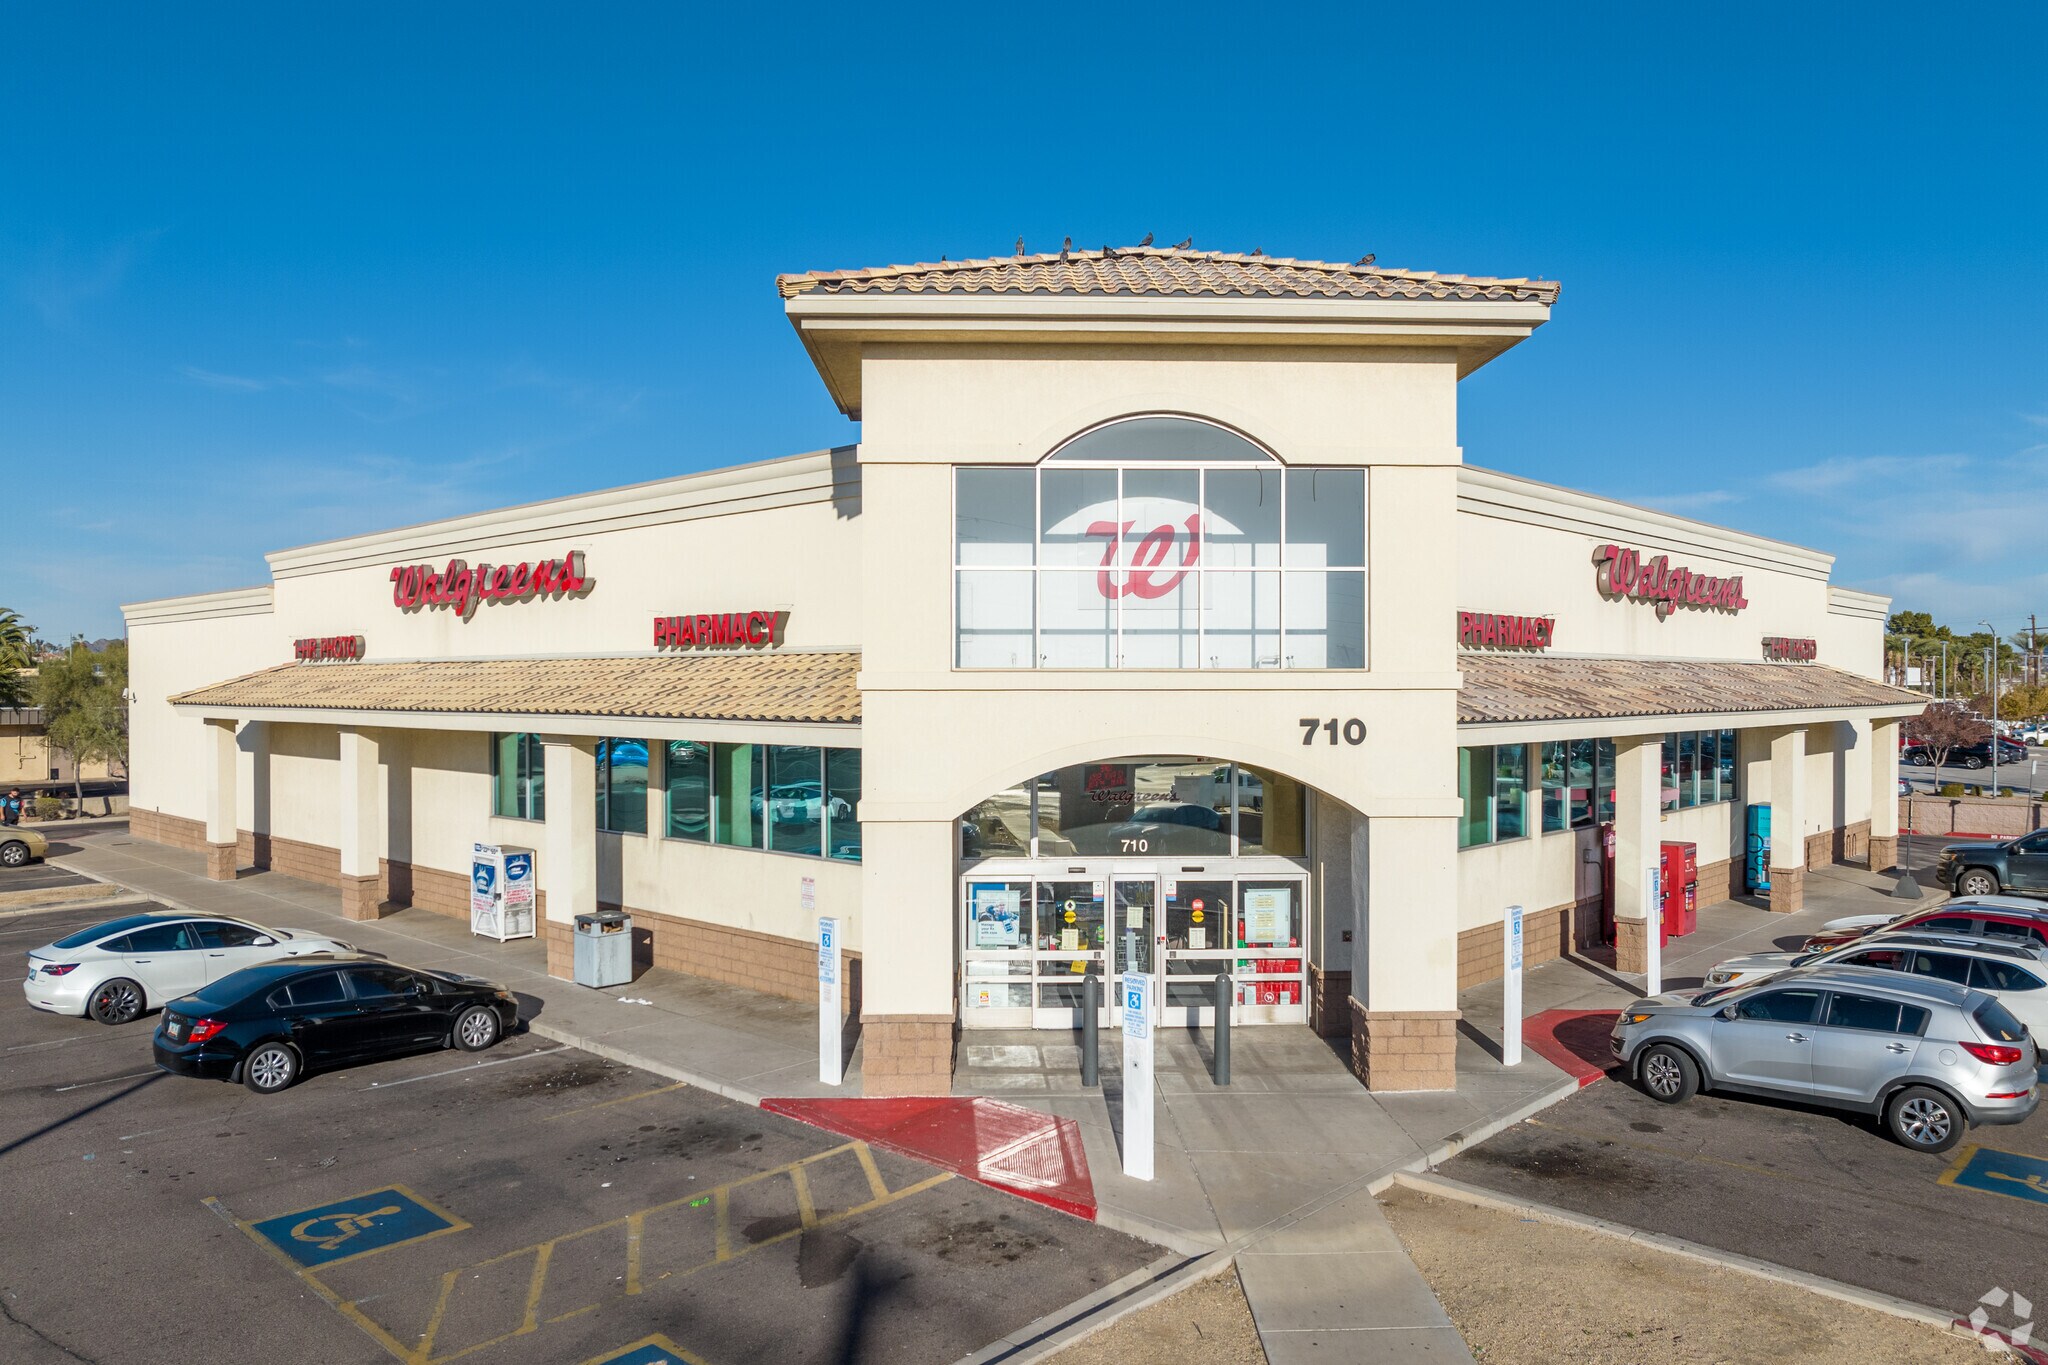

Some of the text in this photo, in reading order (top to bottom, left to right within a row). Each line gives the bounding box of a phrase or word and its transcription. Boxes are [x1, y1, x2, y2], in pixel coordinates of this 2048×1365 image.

[390, 550, 585, 617] Walgreens
[1601, 544, 1749, 616] Walgreens
[653, 610, 782, 648] PHARMACY
[1459, 610, 1556, 648] PHARMACY
[320, 635, 359, 659] PHOTO
[1299, 717, 1367, 746] 710
[1088, 789, 1181, 806] Walgreens
[1120, 839, 1149, 853] 710
